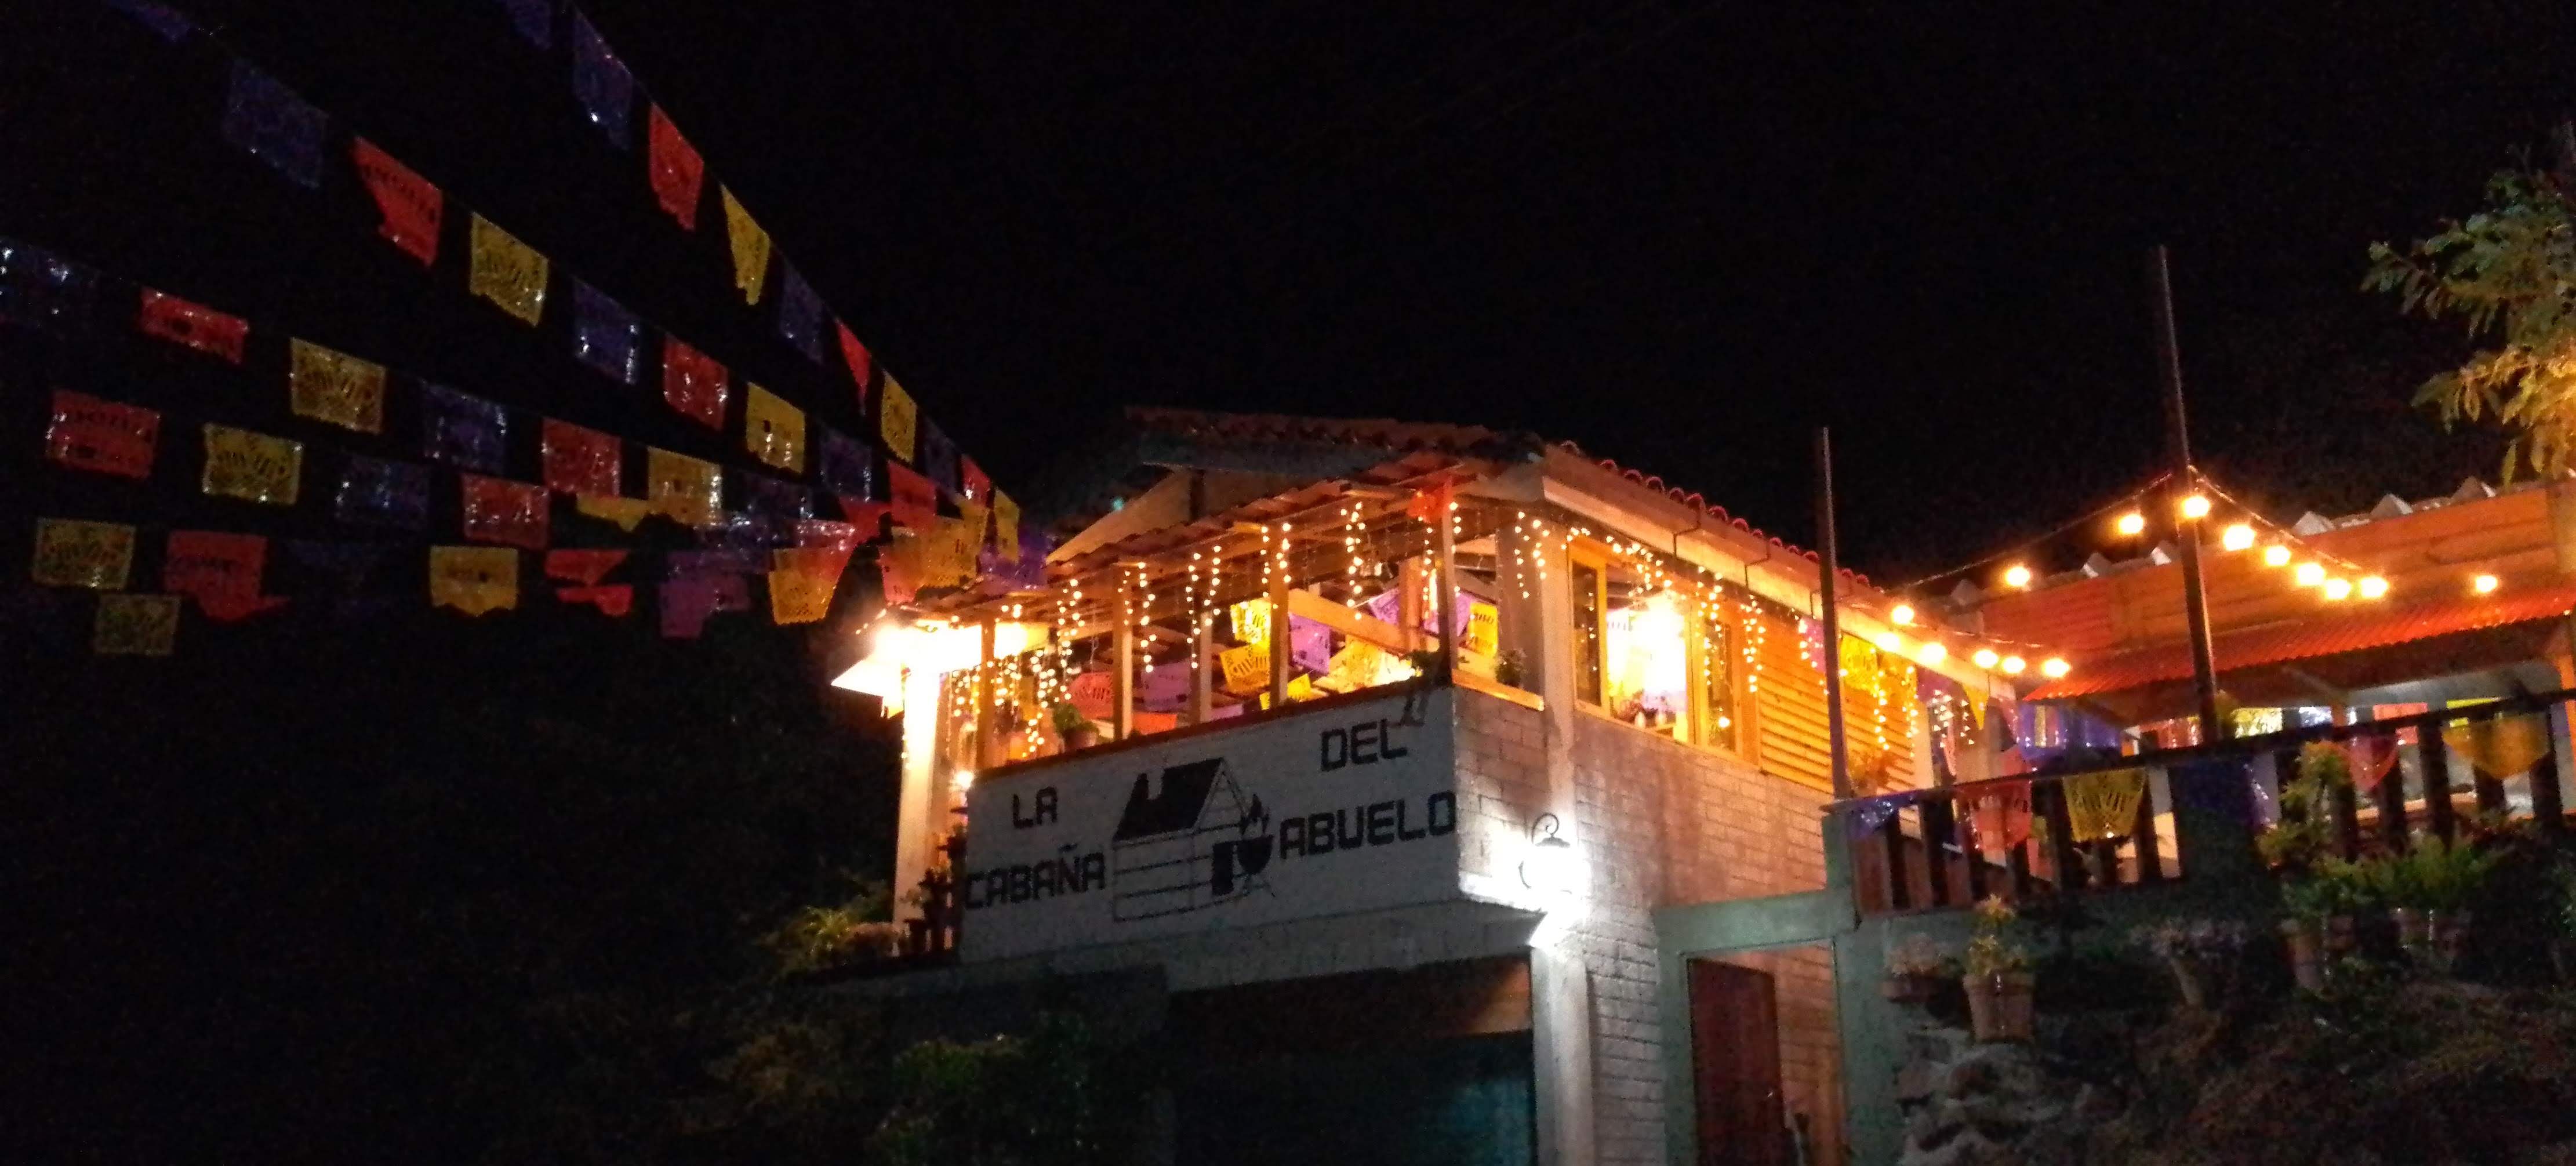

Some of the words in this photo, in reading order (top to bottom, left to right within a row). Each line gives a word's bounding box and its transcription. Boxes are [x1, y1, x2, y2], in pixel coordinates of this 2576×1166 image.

[1321, 718, 1407, 771] DEL
[1013, 786, 1058, 829] LA
[1280, 791, 1456, 860] ABUELO
[965, 844, 1104, 909] CABAÑA
